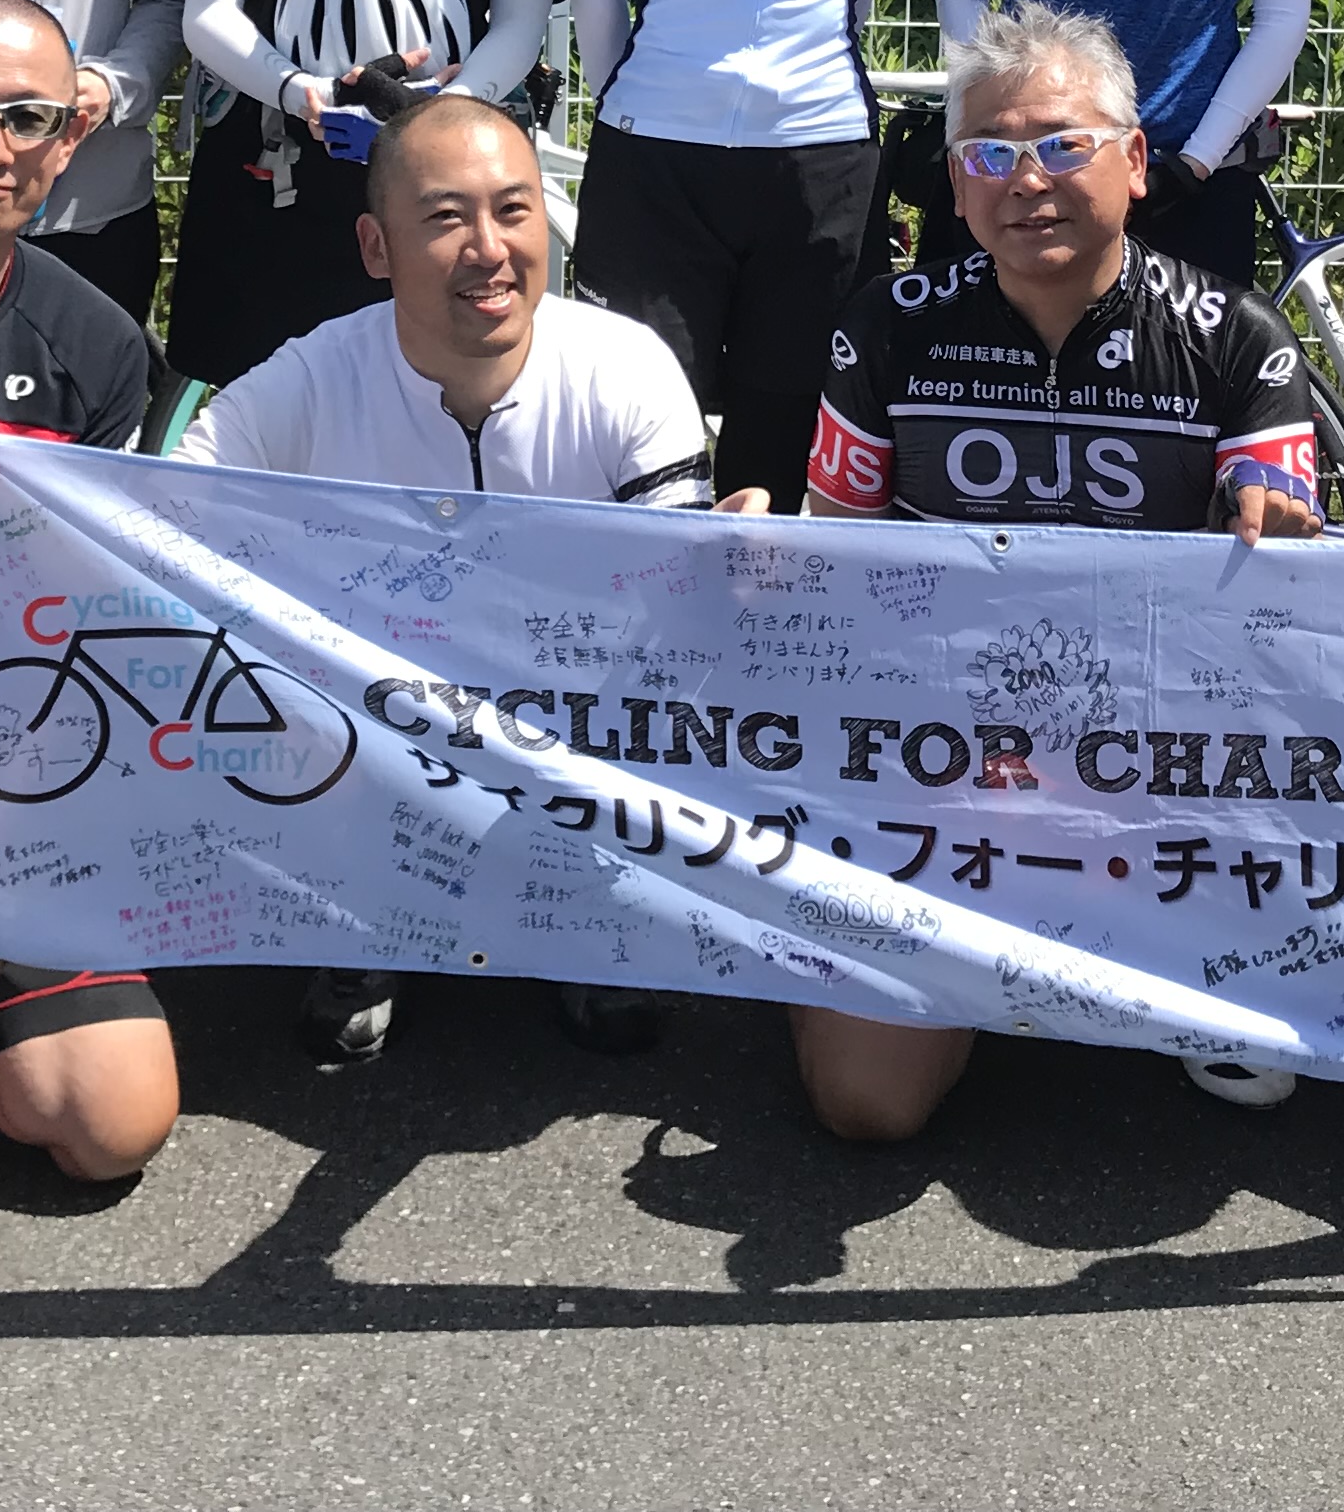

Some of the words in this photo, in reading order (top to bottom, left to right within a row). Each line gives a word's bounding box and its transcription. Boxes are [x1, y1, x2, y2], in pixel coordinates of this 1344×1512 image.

[907, 375, 965, 402] keep
[972, 379, 1061, 409] turning
[1069, 385, 1098, 407] all
[1106, 387, 1145, 410] the
[1152, 393, 1200, 420] way
[946, 428, 1145, 509] OJS
[965, 505, 1000, 515] OGAWA
[1102, 515, 1135, 526] SOGYO
[23, 588, 195, 646] Cycling
[524, 610, 632, 643] 安全第一!
[127, 658, 186, 690] For
[1000, 660, 1056, 695] 2000
[149, 722, 311, 780] Charity
[363, 677, 804, 772] CYCLING
[839, 717, 1038, 791] FOR
